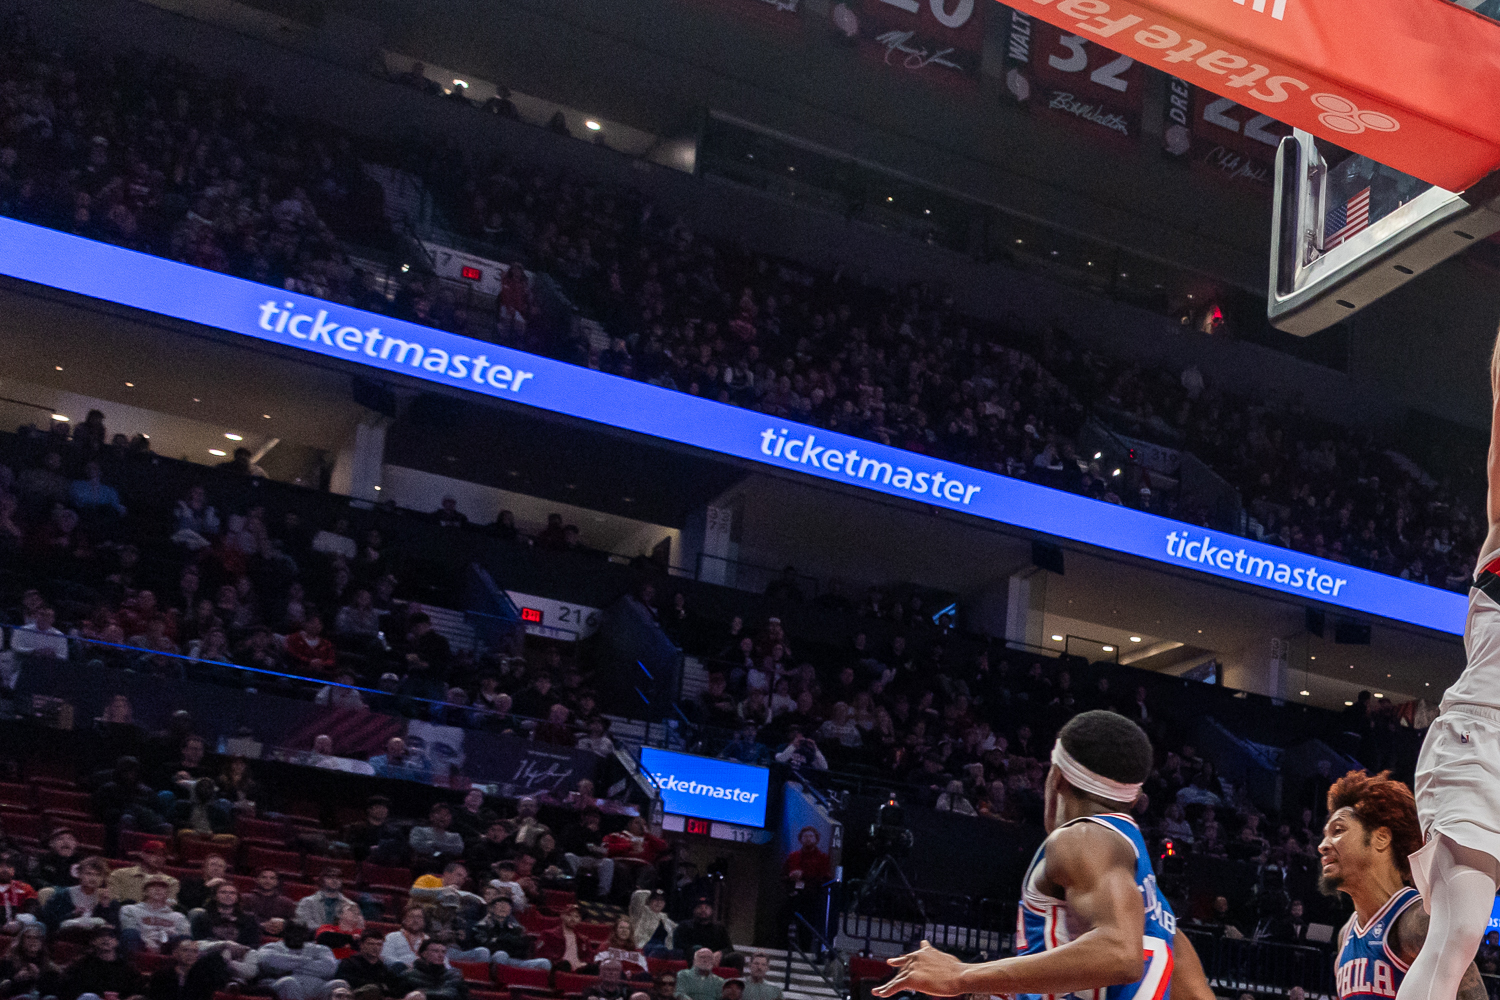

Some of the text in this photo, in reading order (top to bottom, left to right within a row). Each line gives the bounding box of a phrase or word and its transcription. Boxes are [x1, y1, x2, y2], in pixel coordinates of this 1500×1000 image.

[1009, 9, 1031, 63] WALT
[259, 301, 534, 392] ticketmaster
[761, 428, 981, 505] ticketmaster
[1166, 531, 1347, 597] ticketmaster
[558, 606, 597, 628] 216
[1337, 957, 1396, 1000] PHILA
